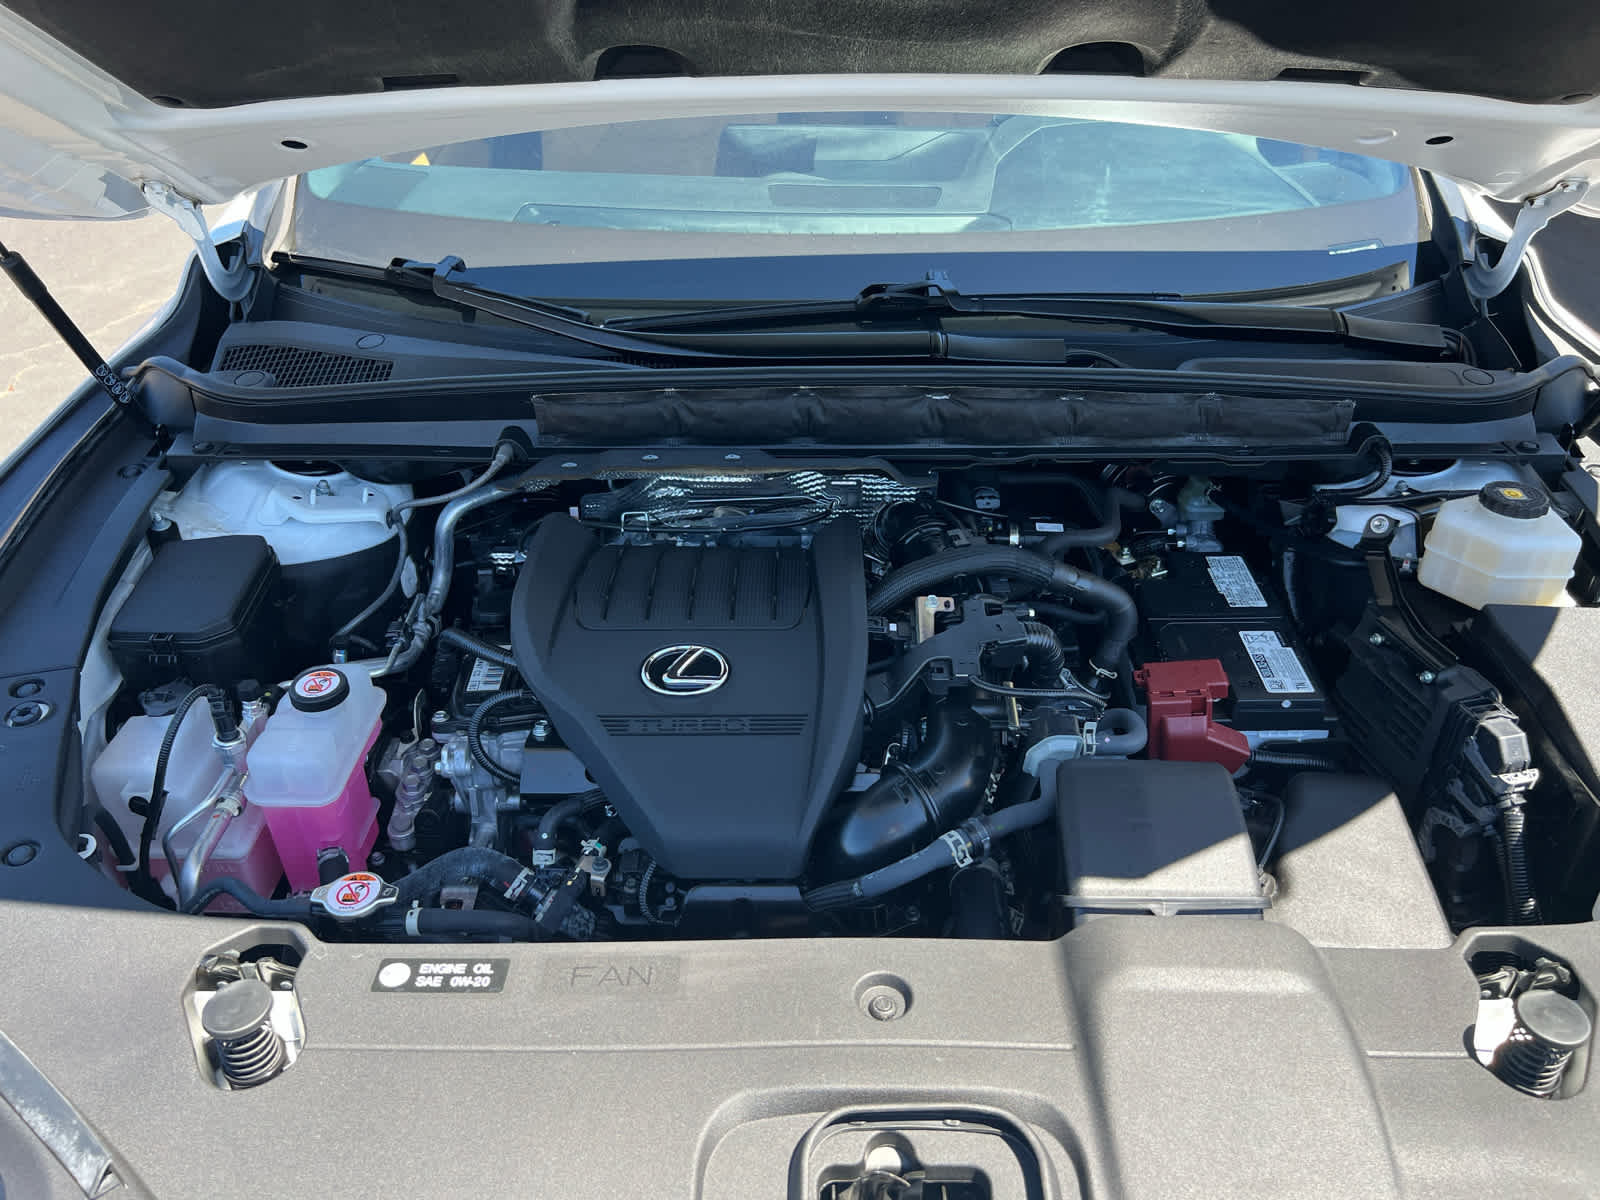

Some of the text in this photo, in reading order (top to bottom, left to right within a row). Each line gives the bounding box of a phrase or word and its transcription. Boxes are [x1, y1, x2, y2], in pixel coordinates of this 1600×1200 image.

[629, 718, 749, 734] TURBO
[418, 963, 495, 975] ENGINE OIL
[570, 965, 653, 987] FAN
[414, 975, 491, 988] SAE 0W-20
